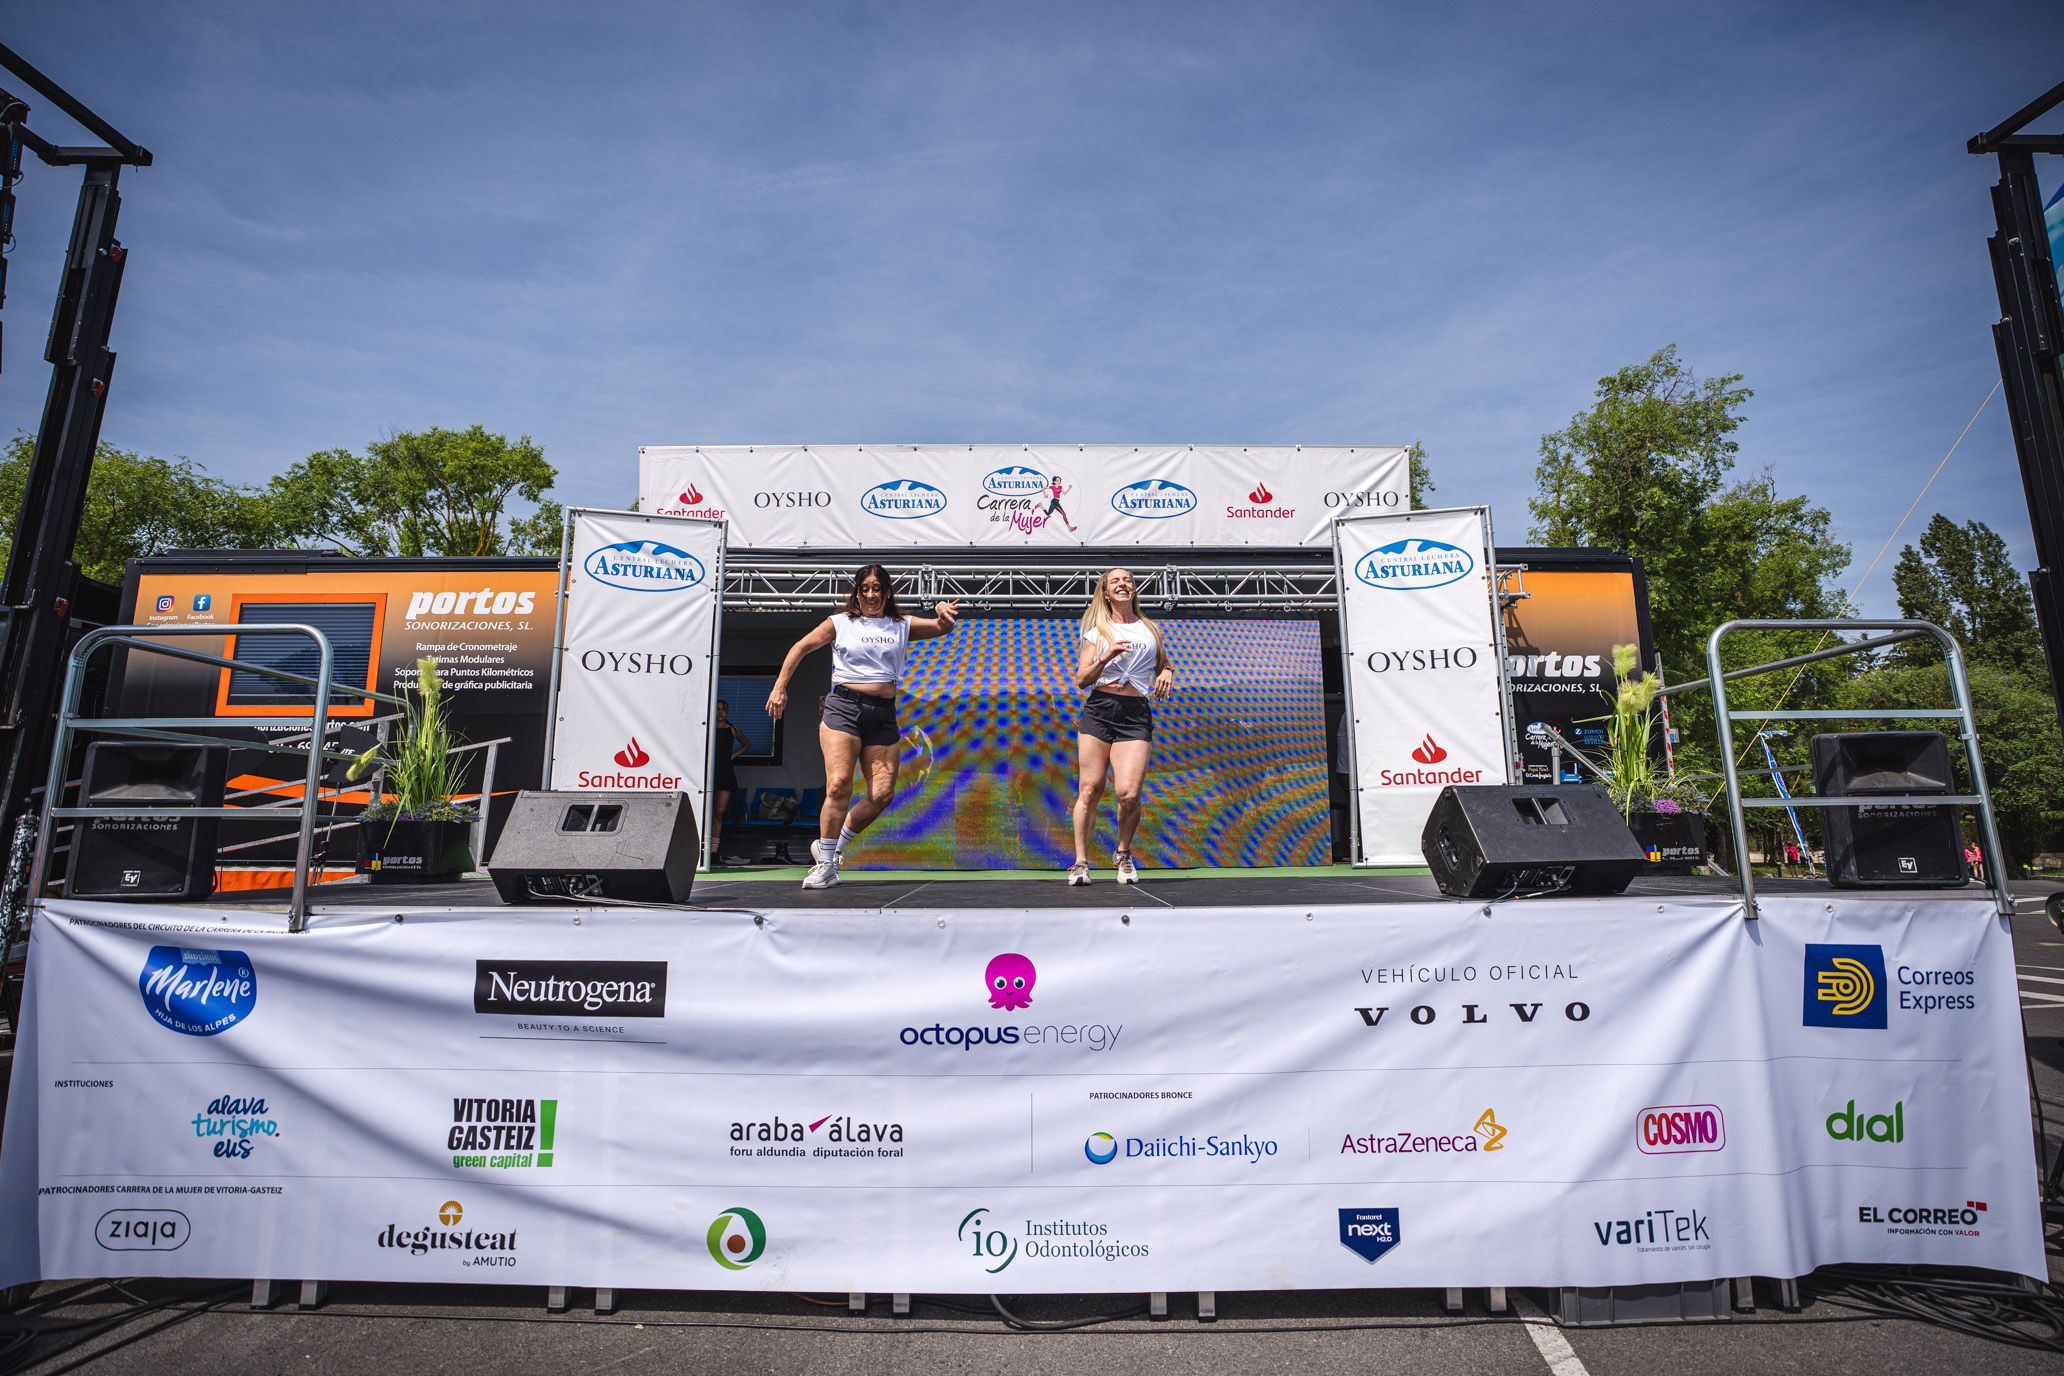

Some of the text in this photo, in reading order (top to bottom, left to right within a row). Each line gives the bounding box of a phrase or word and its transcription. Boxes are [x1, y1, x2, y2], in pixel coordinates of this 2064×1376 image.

[754, 491, 832, 508] OYSHO
[867, 494, 941, 509] ASTURIANA
[977, 495, 1031, 511] Carrera
[1118, 494, 1191, 509] ASTURIANA
[1324, 491, 1399, 509] OYSHO
[990, 511, 1010, 522] de la
[1009, 509, 1051, 535] Mujer
[1227, 507, 1295, 518] Santander
[593, 555, 696, 581] ASTURIANA
[614, 555, 693, 566] CENTRAL LECHERA
[1364, 560, 1465, 579] ASTURIANA
[405, 587, 536, 620] portos
[404, 621, 513, 632] SONORIZACIONES,
[416, 643, 517, 653] Rampa de Cronometraje
[861, 636, 895, 644] OYSHO
[460, 655, 505, 664] Modulares
[582, 650, 693, 676] OYSHO
[1368, 647, 1477, 673] OYSHO
[1508, 651, 1601, 677] ortos
[450, 668, 480, 676] Puntos
[481, 668, 534, 676] Kilométricos
[442, 681, 453, 689] de
[454, 680, 483, 691] gráfica
[485, 680, 532, 691] publicitaria
[578, 771, 682, 790] Santander
[1382, 767, 1483, 786] Santander
[91, 823, 178, 831] SONORIZACIONES
[382, 856, 423, 865] portos
[1662, 846, 1700, 857] portos
[69, 919, 132, 930] PATROCINADORES
[133, 922, 147, 930] DEL
[148, 923, 183, 932] CIRCUITO
[1361, 963, 1579, 984] VEHÍCULO OFICIAL
[1897, 966, 1974, 985] Correos
[1899, 990, 1975, 1014] Express
[155, 1008, 236, 1032] HIJA DE LOS ALPES
[1354, 1001, 1591, 1027] VOLVO
[517, 1023, 554, 1031] BEAUTY
[558, 1024, 570, 1032] TO
[583, 1025, 625, 1034] SCIENCE
[899, 1023, 1123, 1052] octopus energy
[54, 1080, 114, 1089] INSTITUCIONES
[1089, 1091, 1193, 1100] PATROCINADORES BRONCE
[453, 1098, 536, 1123] VITORIA
[729, 1115, 804, 1142] araba
[828, 1115, 903, 1143] álava
[1643, 1110, 1717, 1146] COSMO
[1825, 1099, 1904, 1144] dial
[447, 1125, 536, 1151] GASTEIZ
[1340, 1132, 1478, 1155] AstraZeneca
[213, 1138, 254, 1159] eus
[729, 1146, 903, 1159] foru aldundia diputación foral
[1126, 1134, 1278, 1164] Daiichi-Sankyo
[453, 1152, 533, 1170] green capital
[38, 1185, 283, 1196] PATROCINADORES CARRERA DE LA MUJER DE VITORIA-GASTEIZ
[1859, 1206, 1978, 1226] EL CORREO
[109, 1220, 176, 1246] ziaja
[1025, 1219, 1108, 1236] Institutos
[1347, 1221, 1392, 1237] next
[1593, 1208, 1710, 1246] variTek
[1887, 1227, 1937, 1235] INFORMACIÓN
[377, 1223, 517, 1256] degusteat
[1025, 1240, 1149, 1262] Odontológicos
[472, 1256, 517, 1267] AMUTIO
